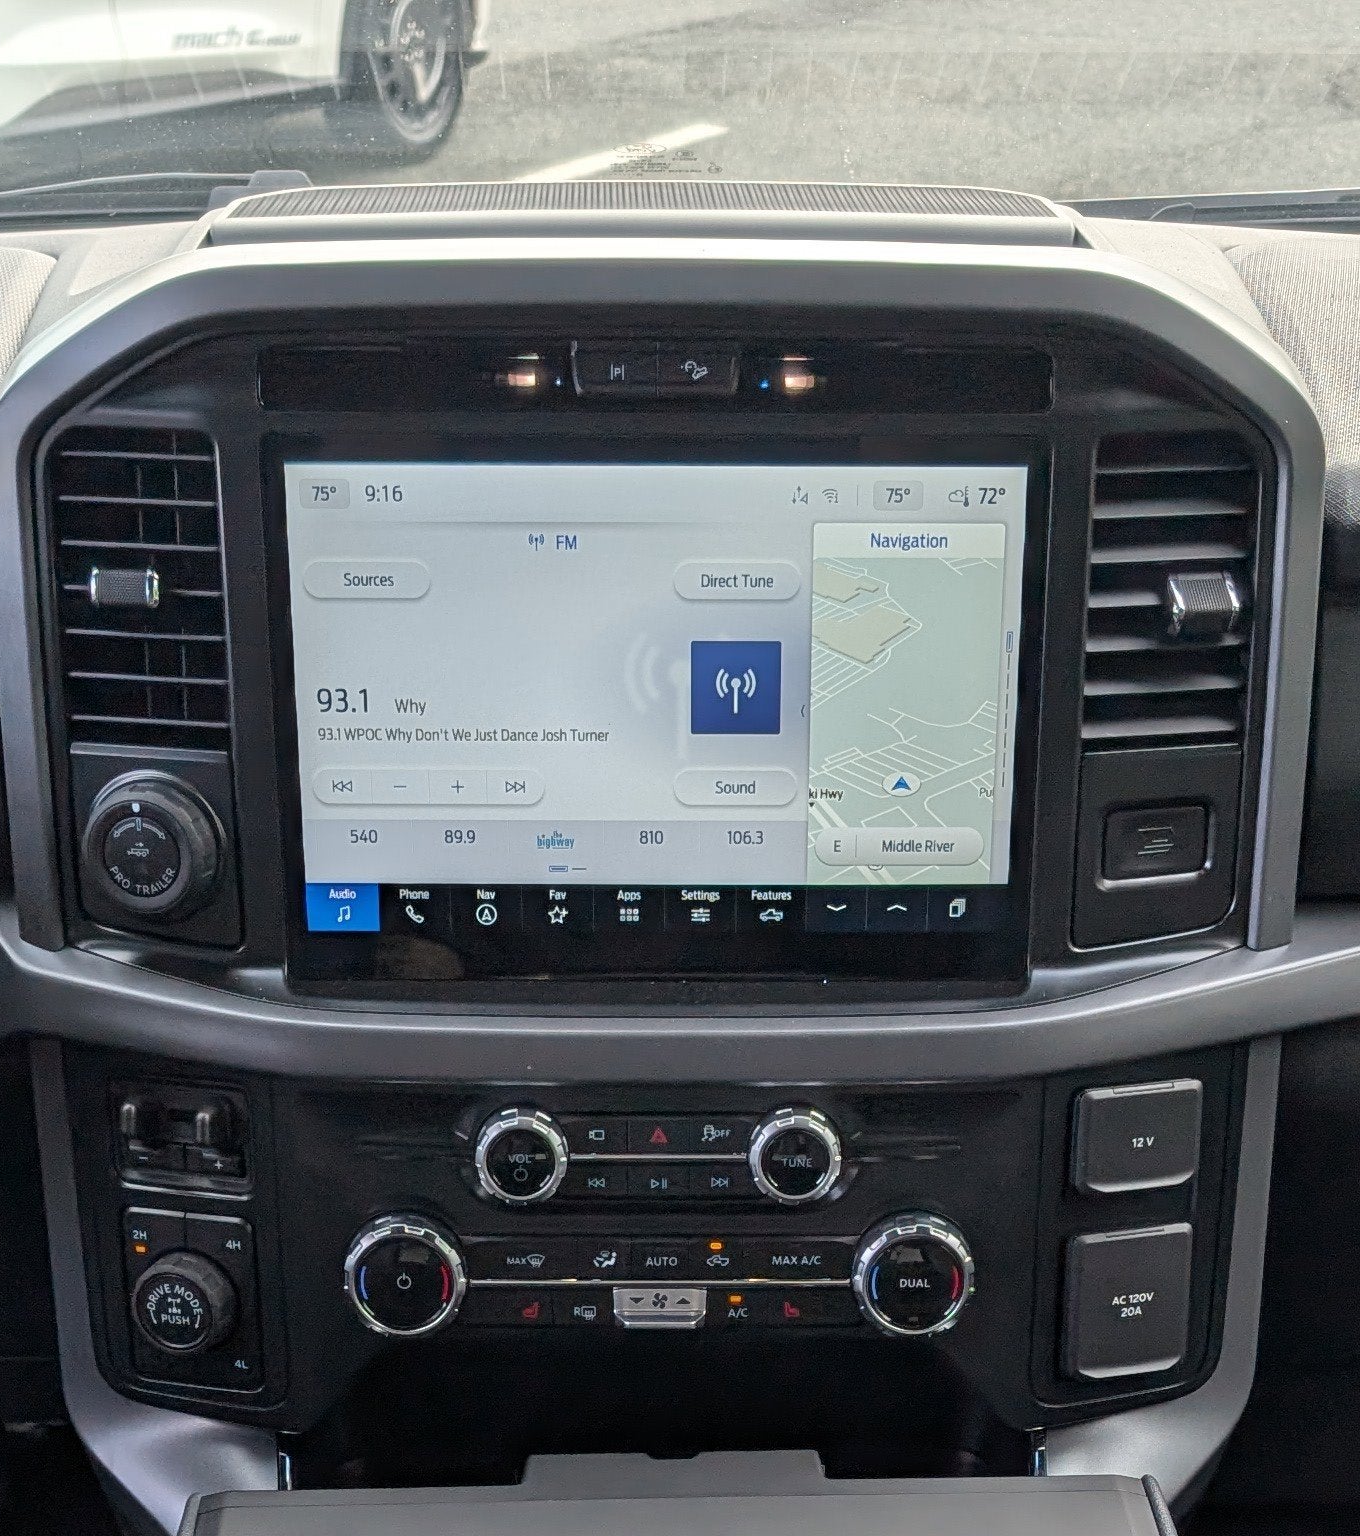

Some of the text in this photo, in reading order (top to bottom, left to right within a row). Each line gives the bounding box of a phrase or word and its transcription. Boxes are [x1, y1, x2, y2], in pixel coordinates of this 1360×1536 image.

[364, 485, 403, 503] 9:16
[556, 535, 577, 550] FM
[870, 533, 948, 550] Navigation
[343, 572, 395, 587] Sources
[700, 574, 774, 588] Direct Tune
[316, 688, 369, 713] 93.1
[394, 698, 427, 715] Why
[317, 728, 609, 744] 93.1 WPOC Why Don't We Just Dance Josh Turner
[714, 780, 757, 795] Sound
[820, 789, 843, 801] Hwy
[350, 829, 378, 844] 540
[444, 829, 476, 844] 89.9
[639, 830, 664, 845] 810
[727, 830, 764, 845] 106.3
[833, 840, 842, 852] E
[881, 840, 955, 852] Middle River
[110, 866, 175, 895] PRO TRAILER
[329, 889, 356, 900] Audio
[399, 889, 429, 900] Phone
[476, 889, 496, 900] Nav
[549, 889, 567, 900] Fav
[617, 889, 641, 902] Apps
[681, 889, 720, 903] Settings
[751, 889, 792, 901] Features
[714, 1129, 731, 1138] OFF
[1132, 1136, 1155, 1148] 12 V
[508, 1154, 532, 1164] VOL
[782, 1157, 812, 1168] TUNE
[132, 1230, 147, 1240] 2H
[225, 1239, 241, 1251] 4H
[506, 1256, 527, 1265] MAX
[645, 1256, 678, 1267] AUTO
[771, 1255, 821, 1266] MAX A/C
[899, 1277, 931, 1288] DUAL
[147, 1283, 203, 1315] DRIVE MODE
[1112, 1292, 1154, 1306] AC 120V
[728, 1307, 749, 1319] A/C
[1120, 1306, 1142, 1317] 20A
[161, 1313, 190, 1326] PUSH
[234, 1360, 249, 1370] 4L
